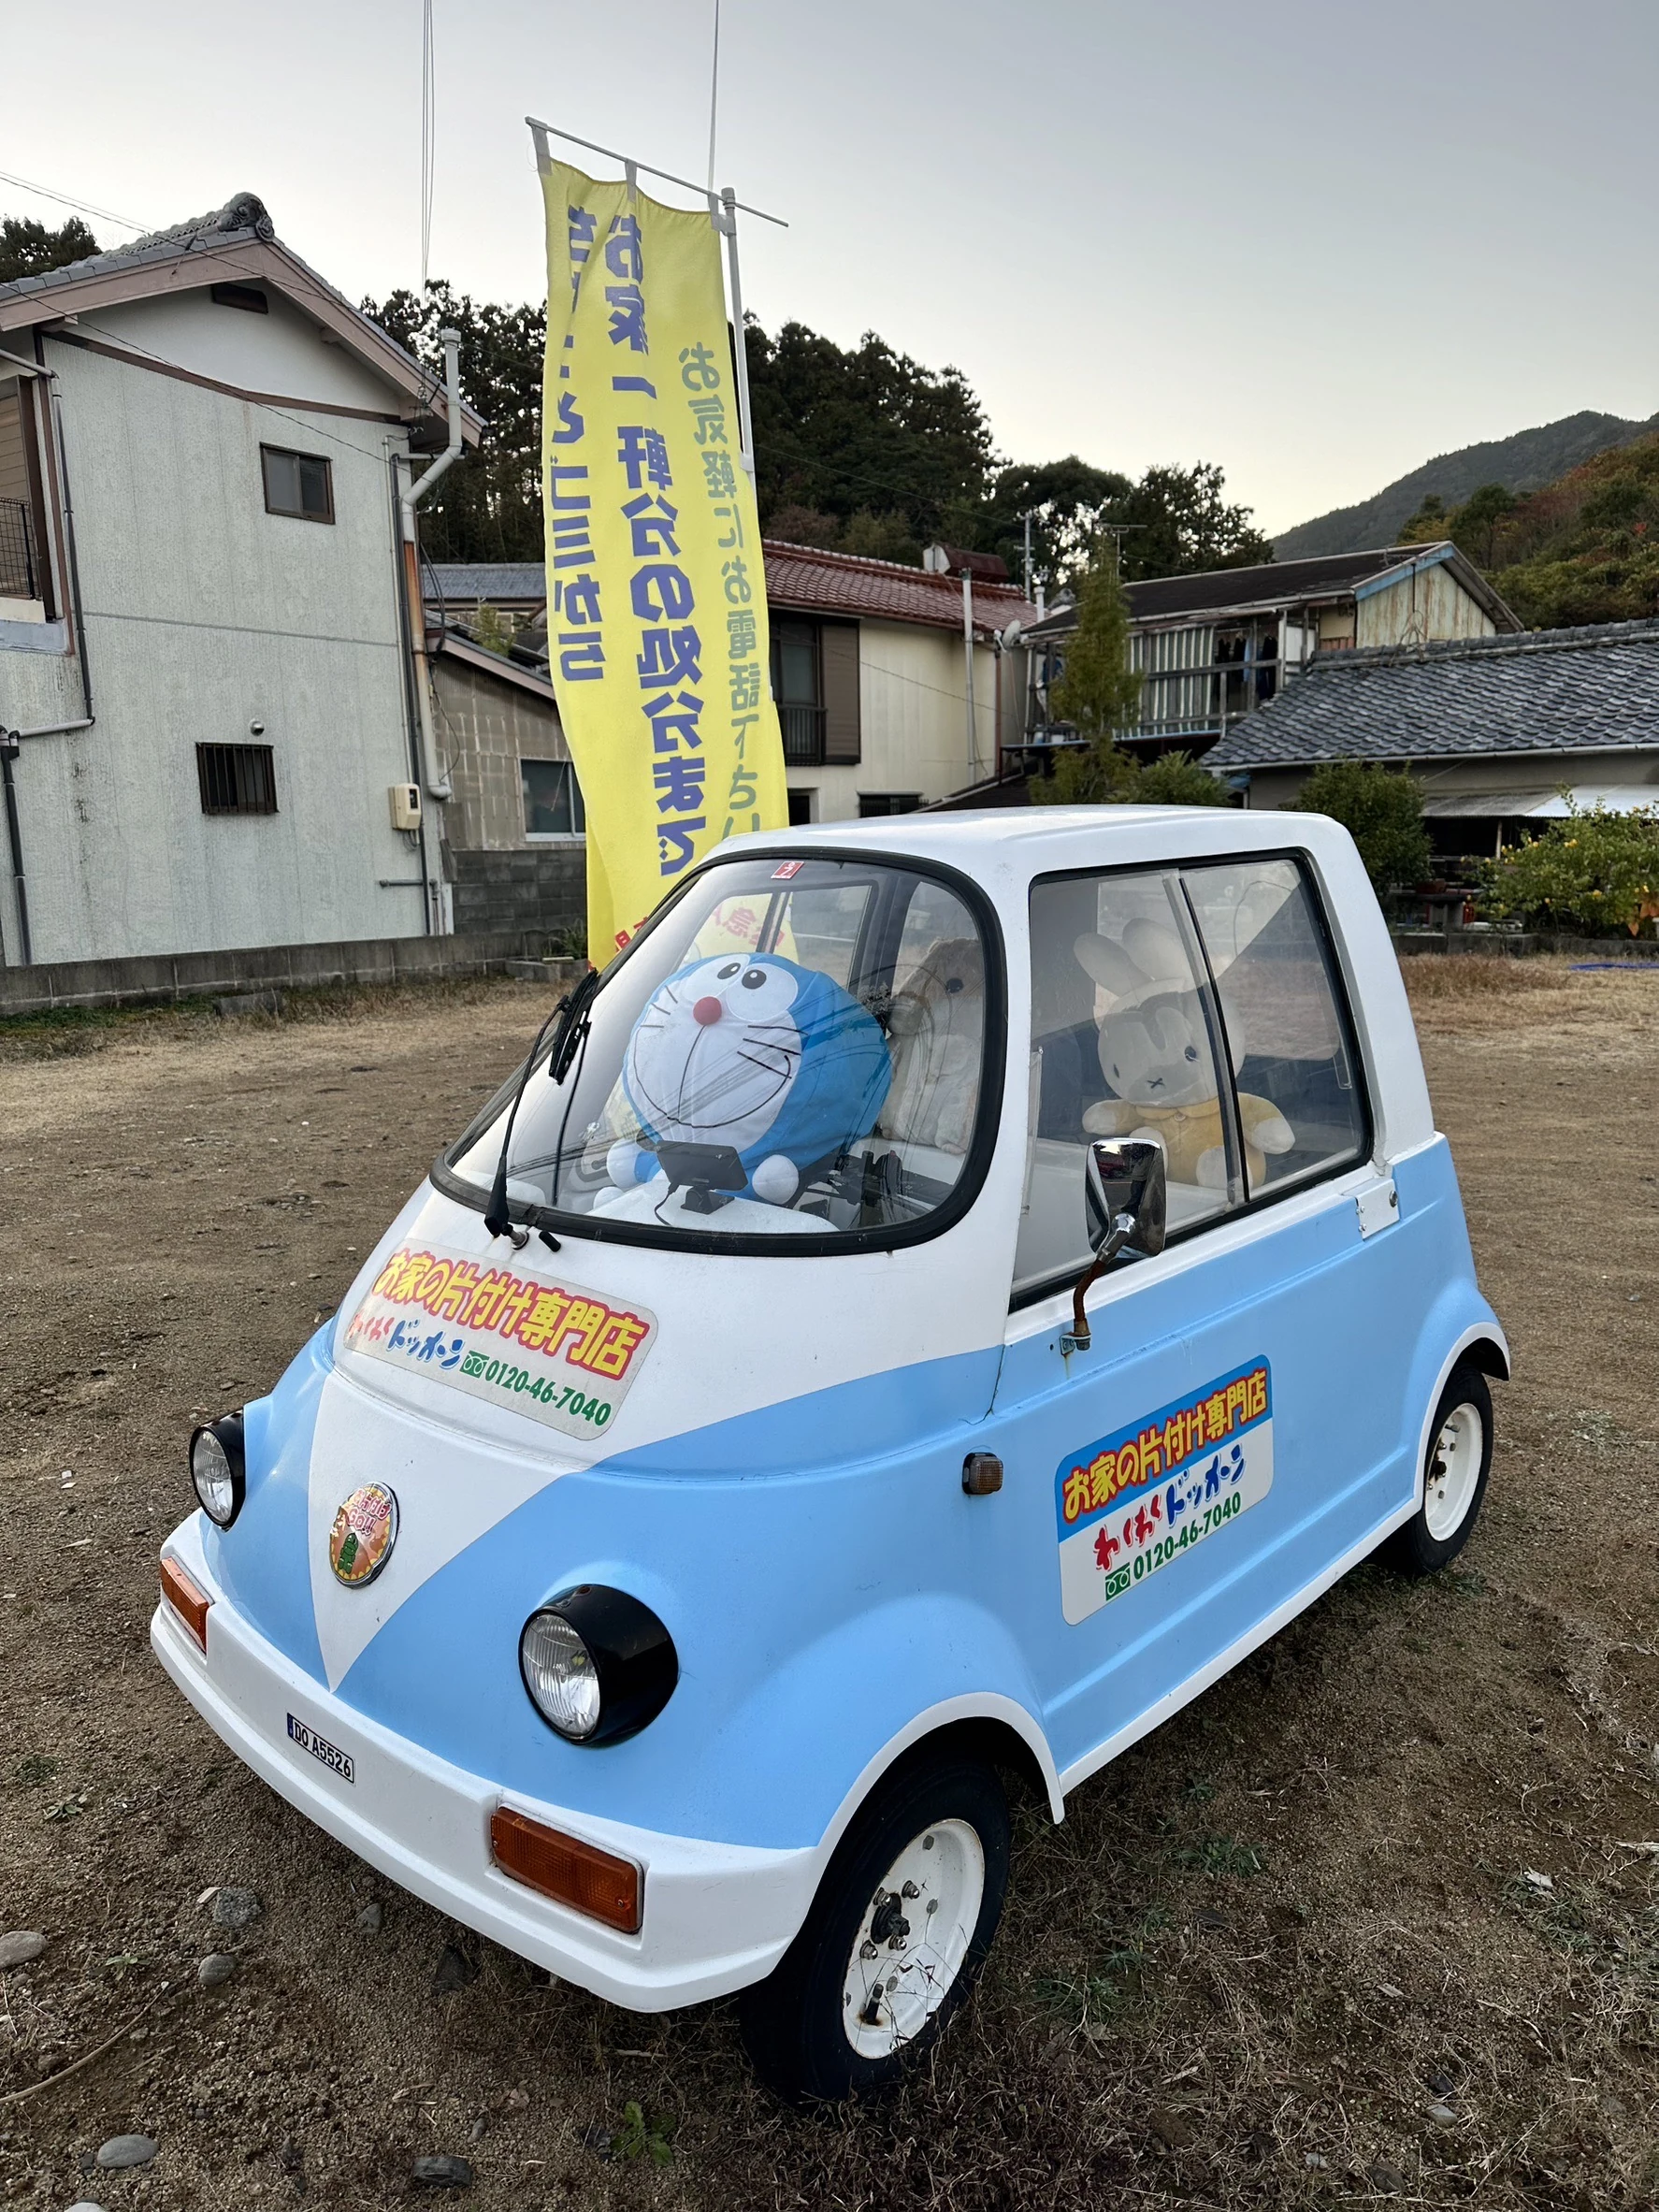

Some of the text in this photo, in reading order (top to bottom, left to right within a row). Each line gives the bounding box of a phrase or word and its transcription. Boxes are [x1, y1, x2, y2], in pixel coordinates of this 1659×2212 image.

[372, 1247, 650, 1381] お家の片付け専門店
[484, 1359, 612, 1427] 0120-46-7040
[1062, 1367, 1267, 1525] お家の片付け専門店
[1133, 1491, 1242, 1581] 0120-46-7040
[294, 1721, 351, 1778] DO A5526
